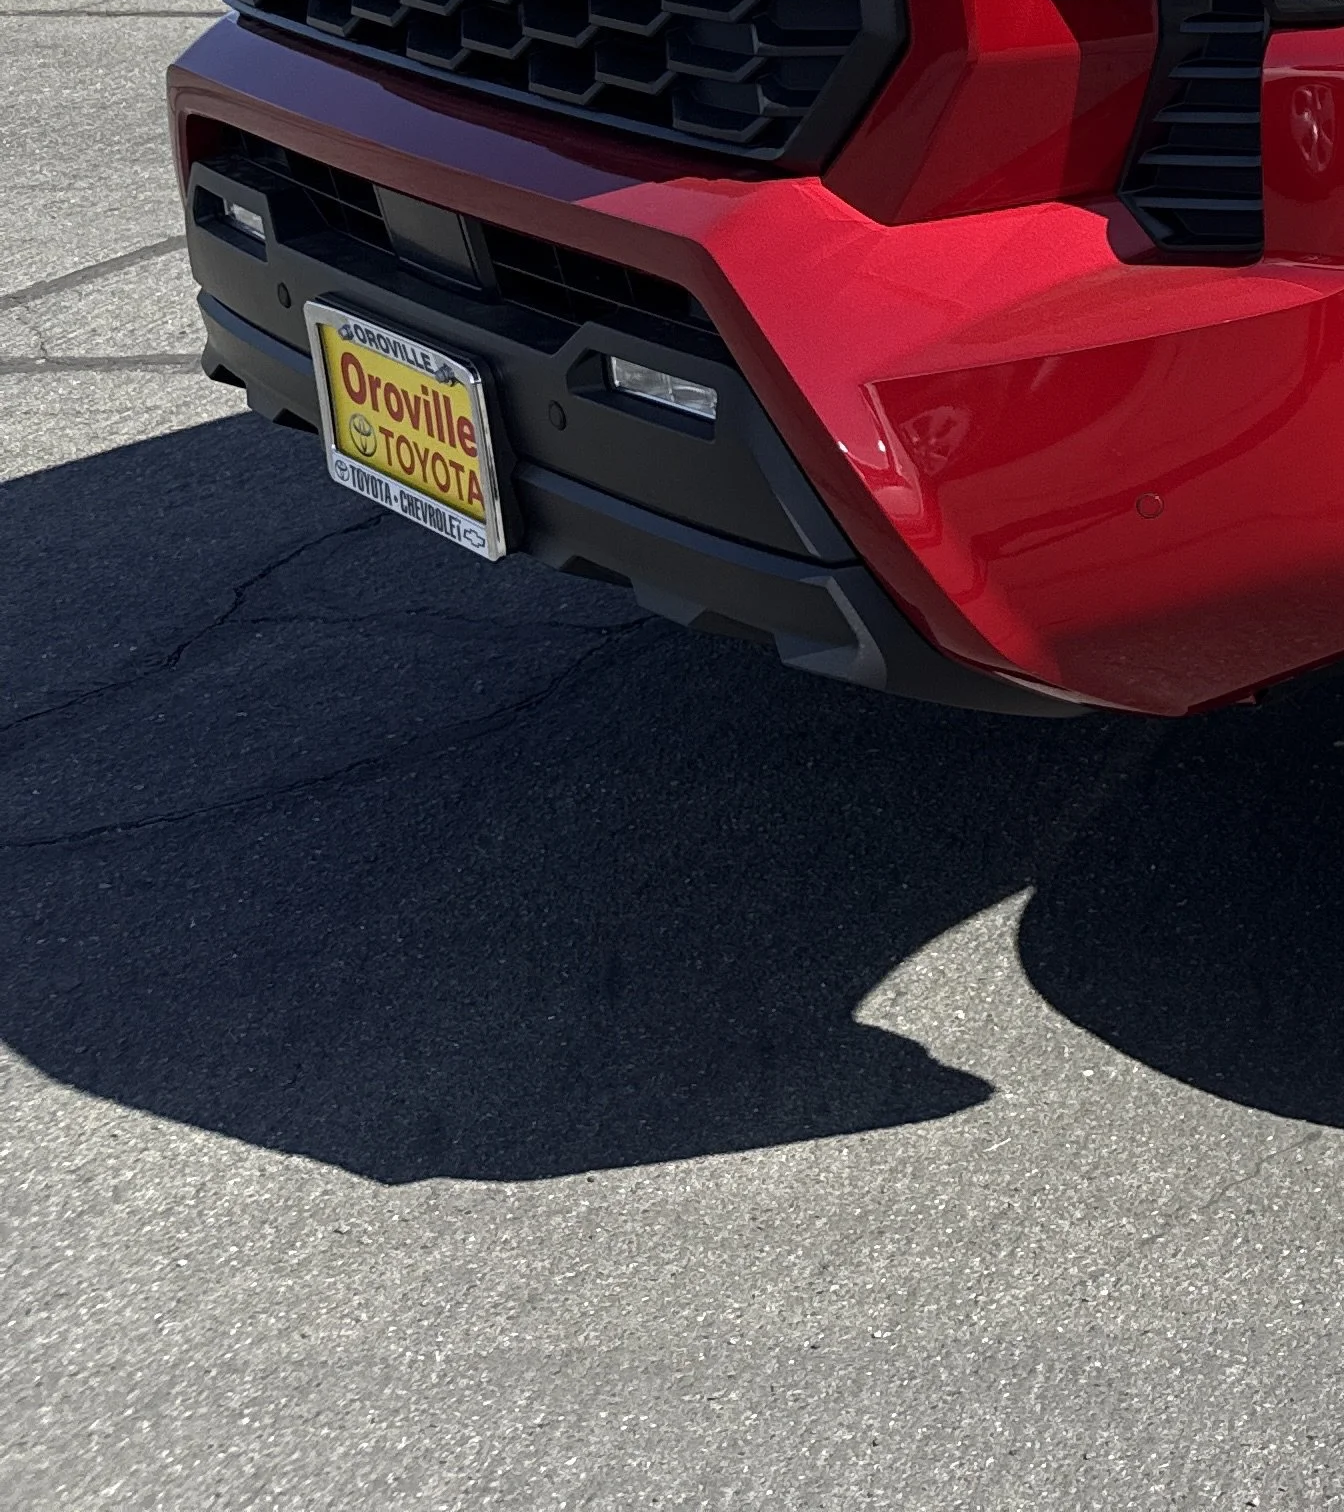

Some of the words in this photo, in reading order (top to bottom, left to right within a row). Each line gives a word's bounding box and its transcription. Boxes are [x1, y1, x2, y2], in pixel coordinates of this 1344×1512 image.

[353, 323, 436, 373] OROVILLE
[341, 352, 478, 458] Oroville
[350, 462, 393, 506] TOYOTA
[400, 489, 462, 541] CHEVROLET
[379, 425, 485, 512] TOYOTA
